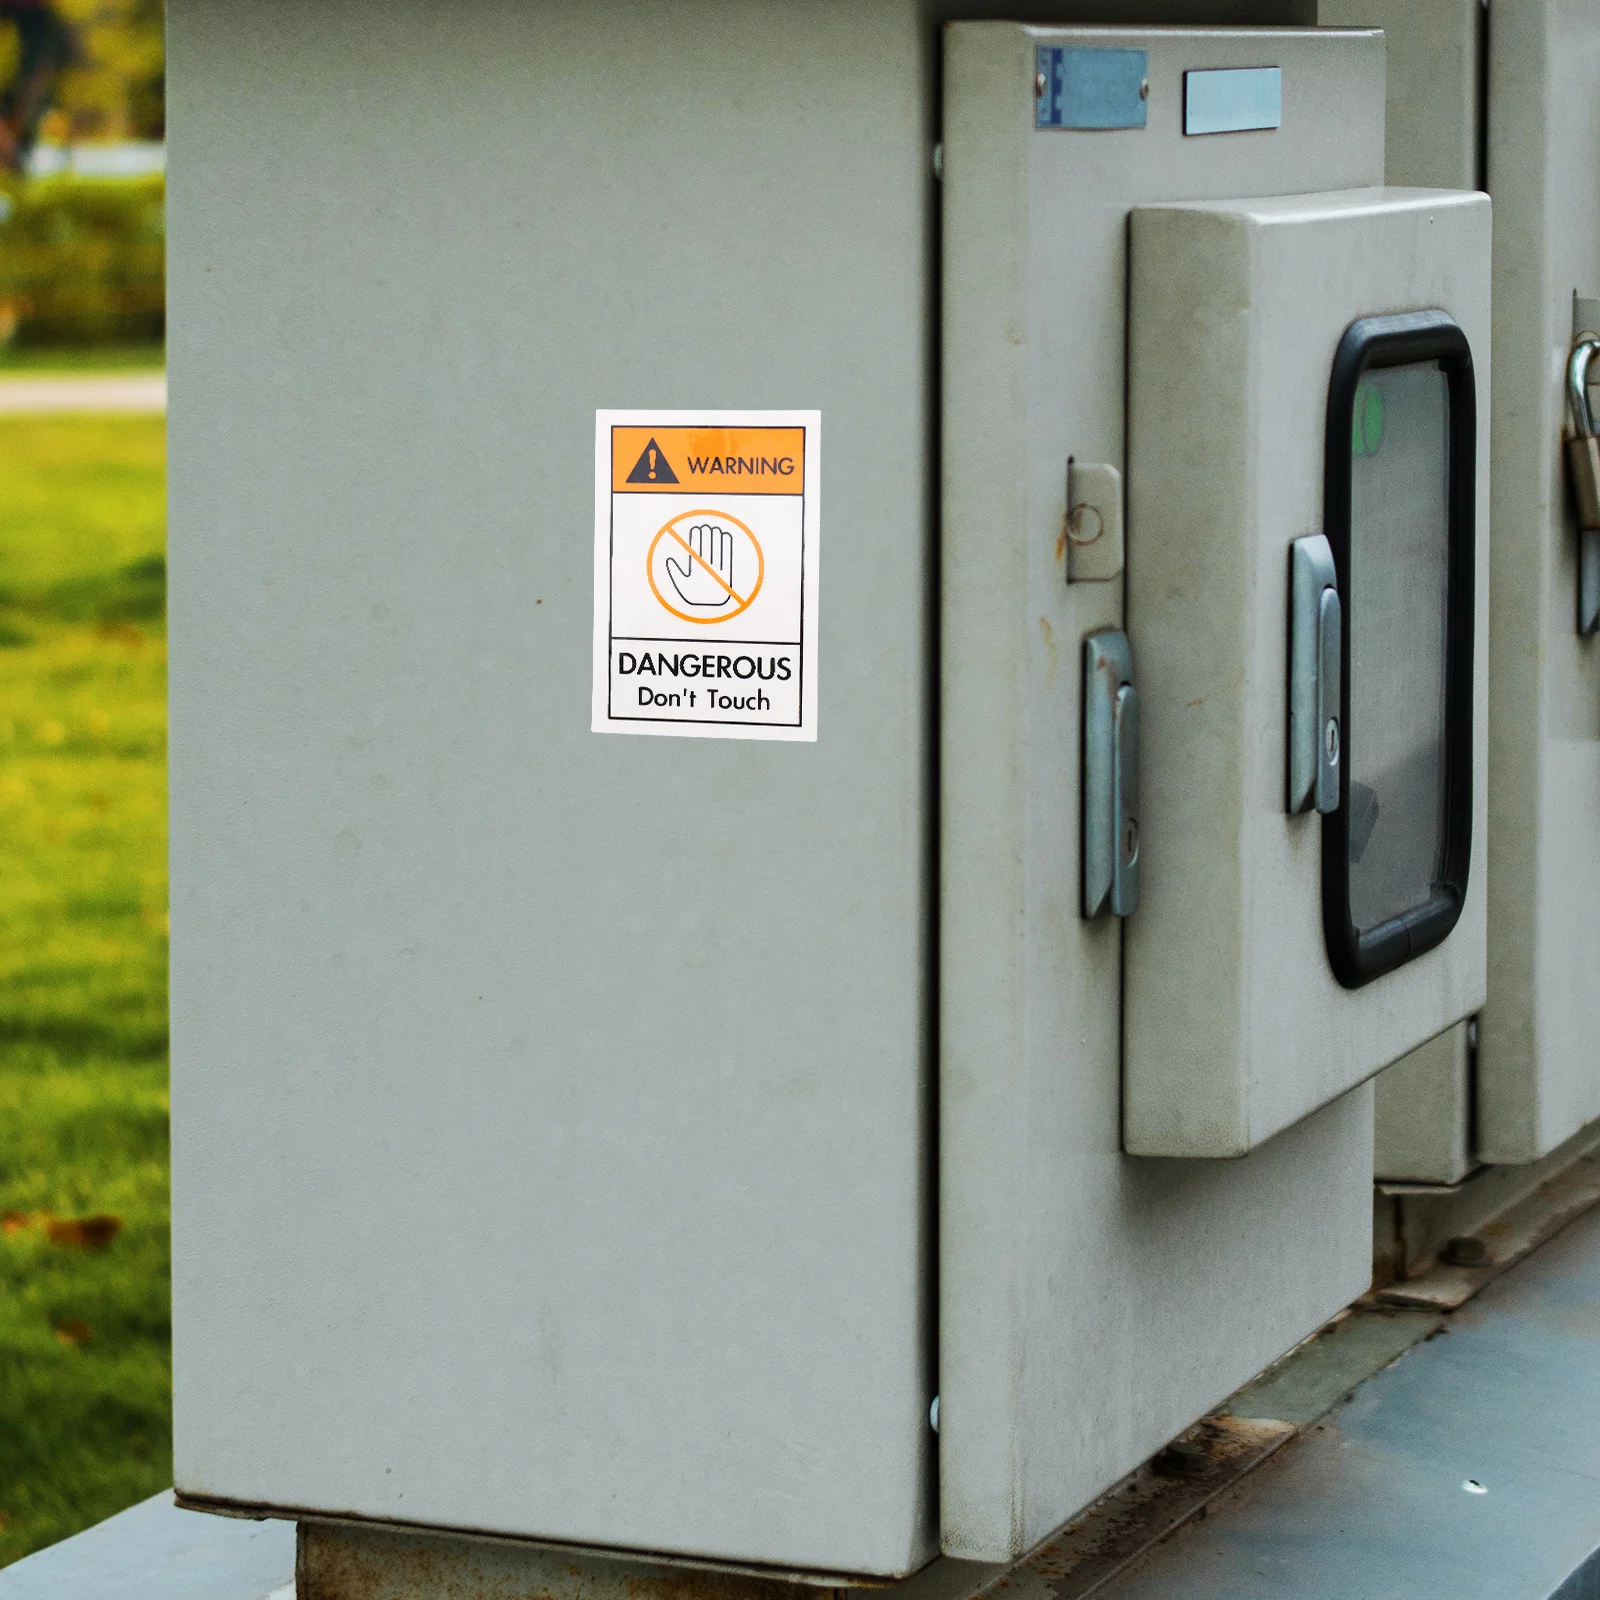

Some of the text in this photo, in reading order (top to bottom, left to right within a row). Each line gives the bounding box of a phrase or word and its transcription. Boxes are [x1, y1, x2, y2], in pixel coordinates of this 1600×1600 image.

[687, 456, 795, 476] WARNING
[618, 652, 792, 681] DANGEROUS
[638, 686, 770, 711] Don't Touch
